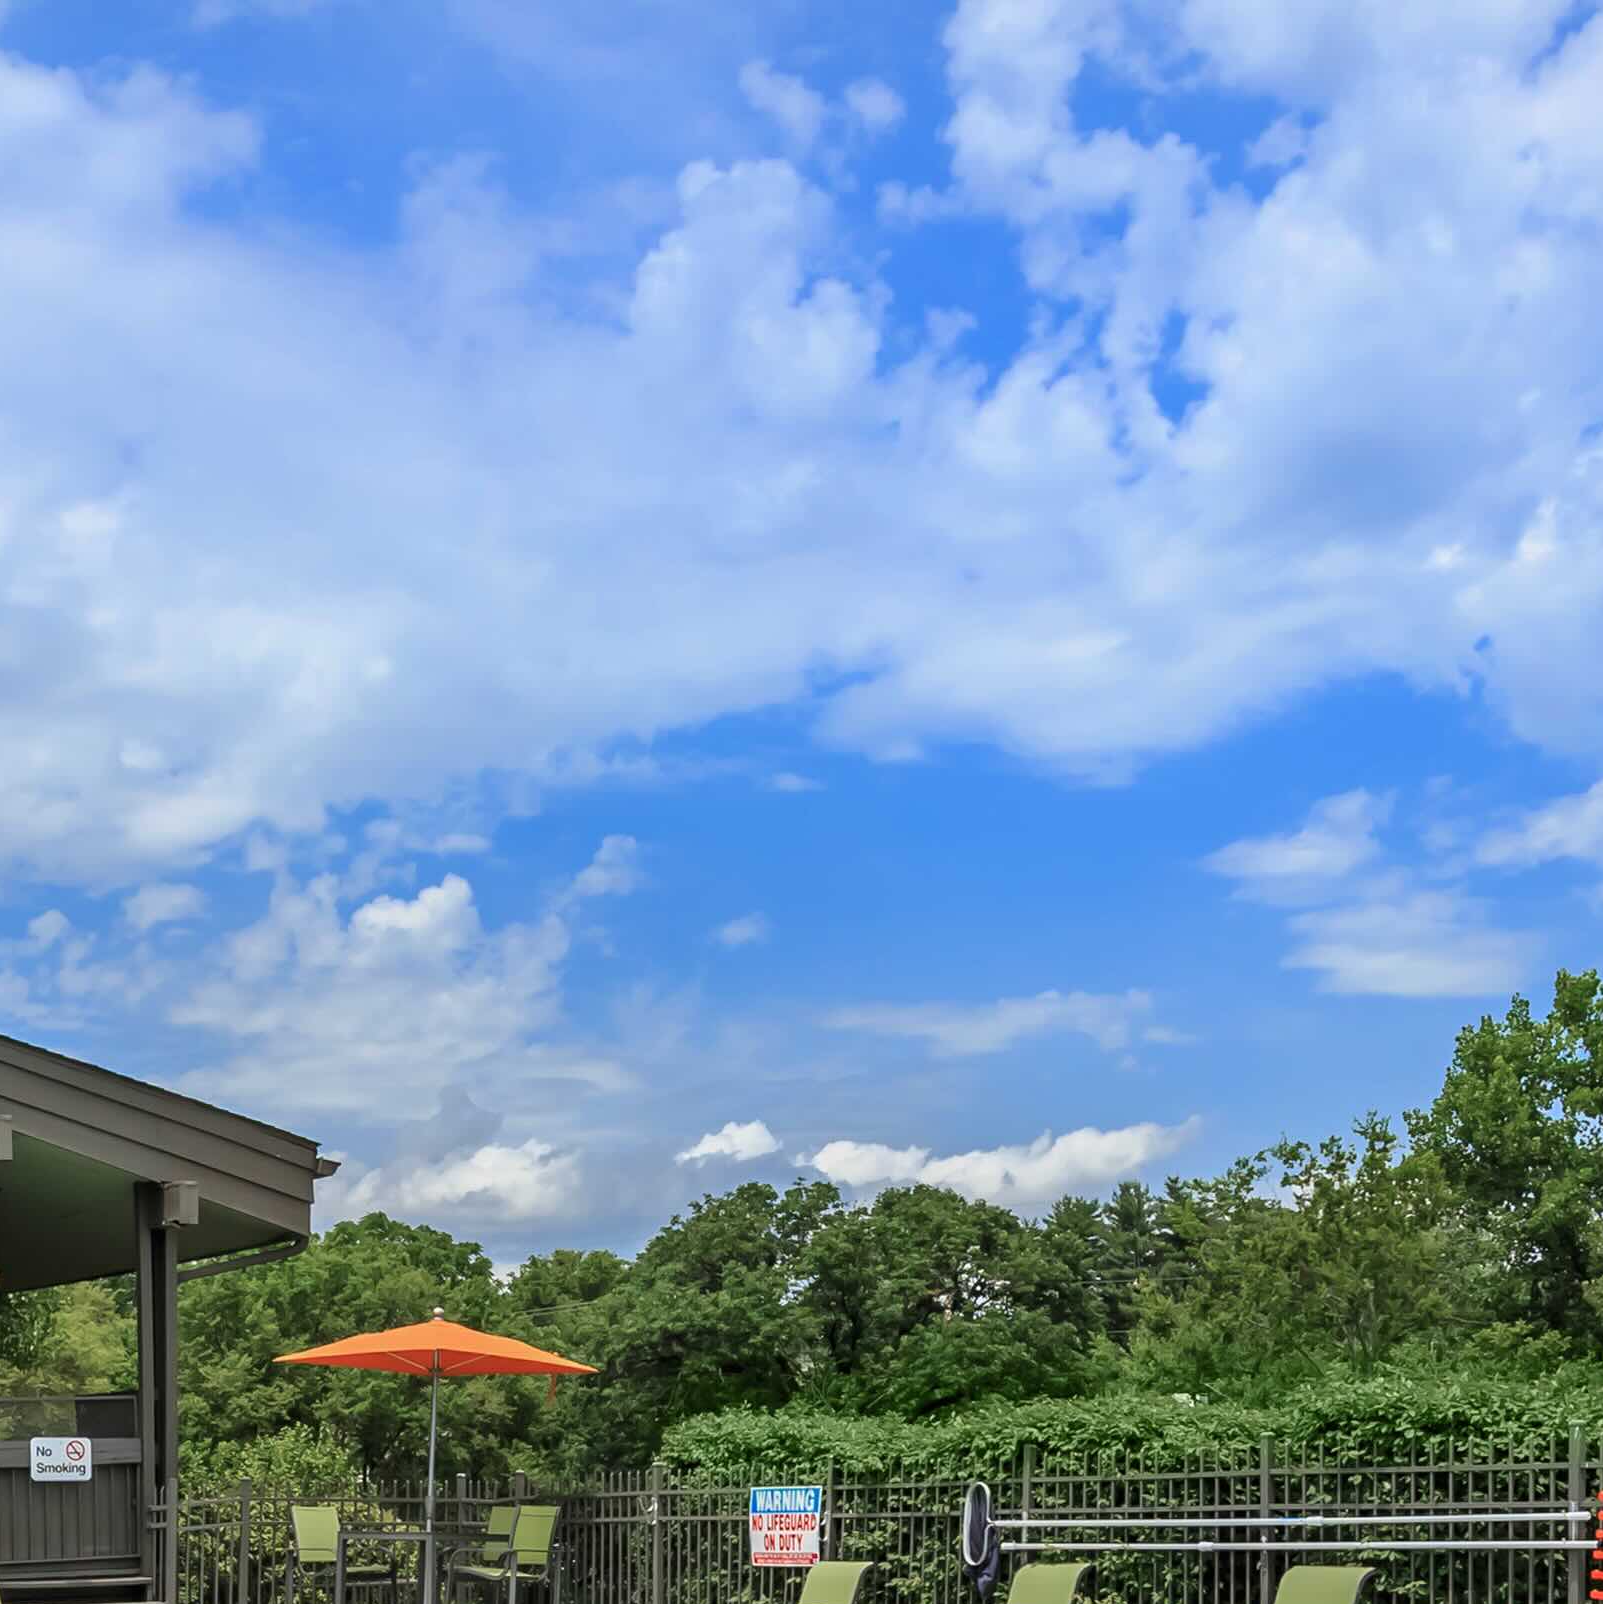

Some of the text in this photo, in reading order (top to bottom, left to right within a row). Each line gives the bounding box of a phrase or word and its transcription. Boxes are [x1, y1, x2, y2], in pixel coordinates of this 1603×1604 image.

[36, 1446, 52, 1457] No
[36, 1462, 86, 1476] Smoking
[756, 1489, 815, 1512] WARNING
[752, 1514, 817, 1531] NO LIFEGUARD
[764, 1534, 804, 1551] ON DUTY
